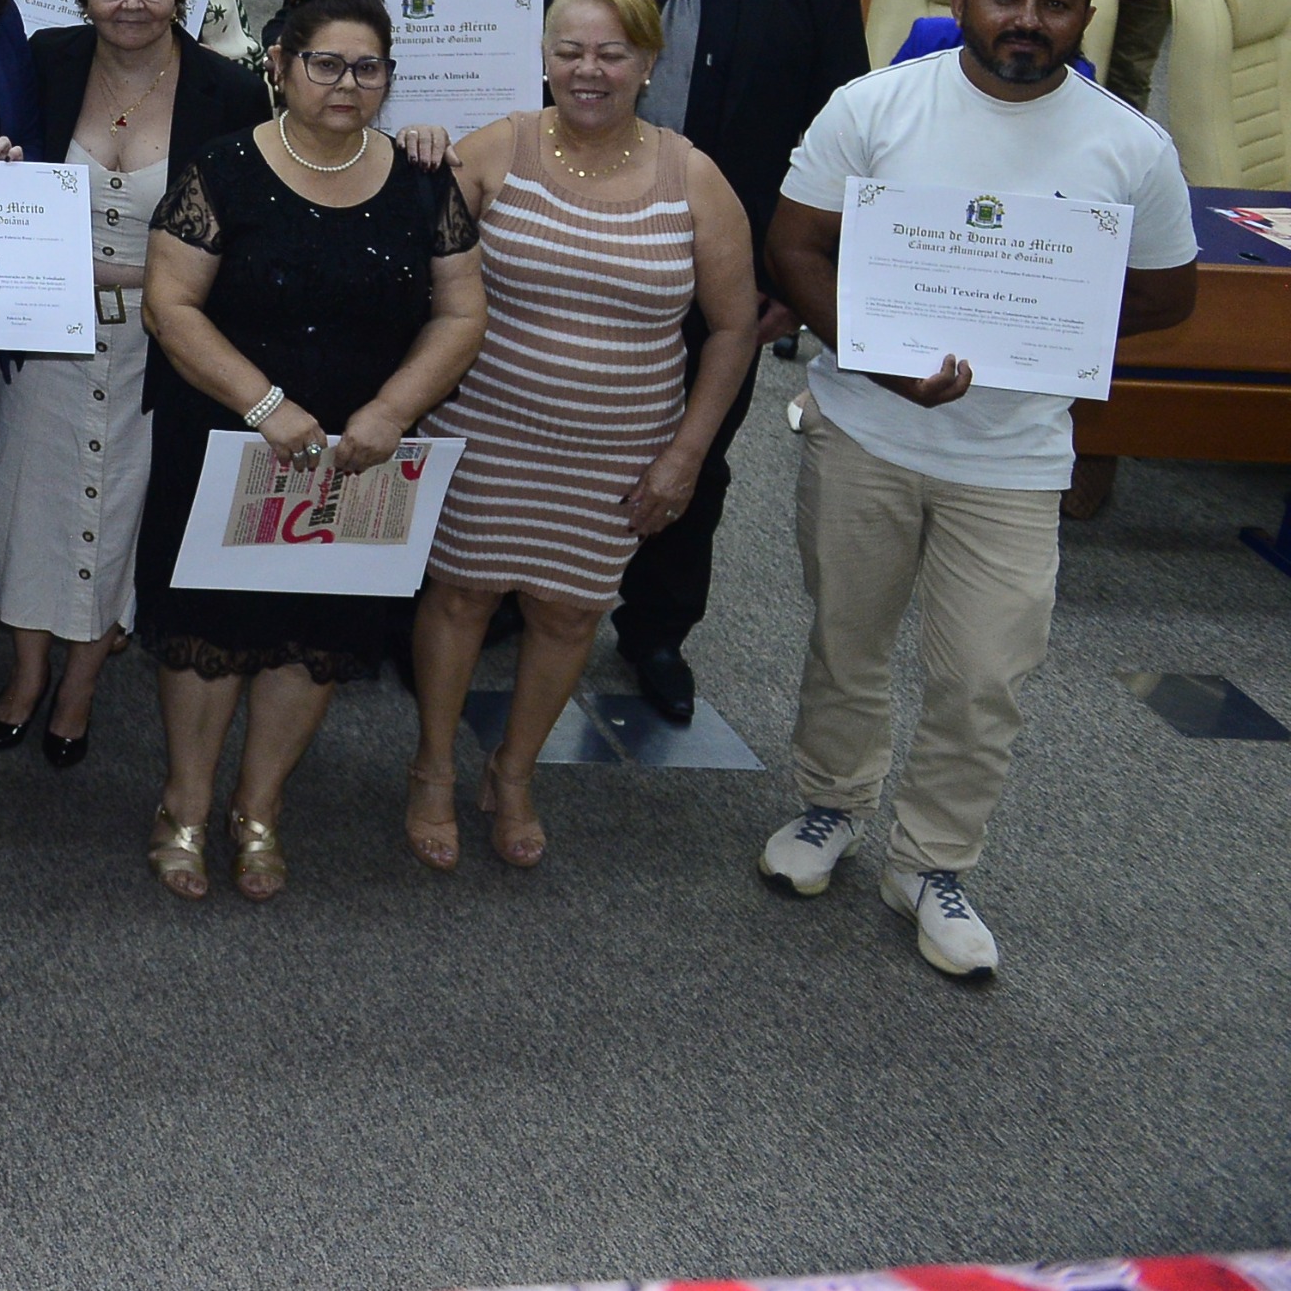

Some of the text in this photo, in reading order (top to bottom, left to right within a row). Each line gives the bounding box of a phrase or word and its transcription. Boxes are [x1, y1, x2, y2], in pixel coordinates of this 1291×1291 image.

[405, 23, 440, 33] Honra
[443, 24, 456, 32] ao
[459, 21, 497, 33] Mérito
[429, 72, 439, 81] de
[443, 71, 480, 80] Almeida
[6, 201, 45, 214] Mérito
[892, 223, 1073, 254] Diploma de Honra ao Mérito
[907, 239, 1054, 265] Câmara Municipal de Goiânia
[914, 282, 948, 295] Claubi
[992, 291, 1006, 301] de
[1008, 292, 1038, 304] Lemo
